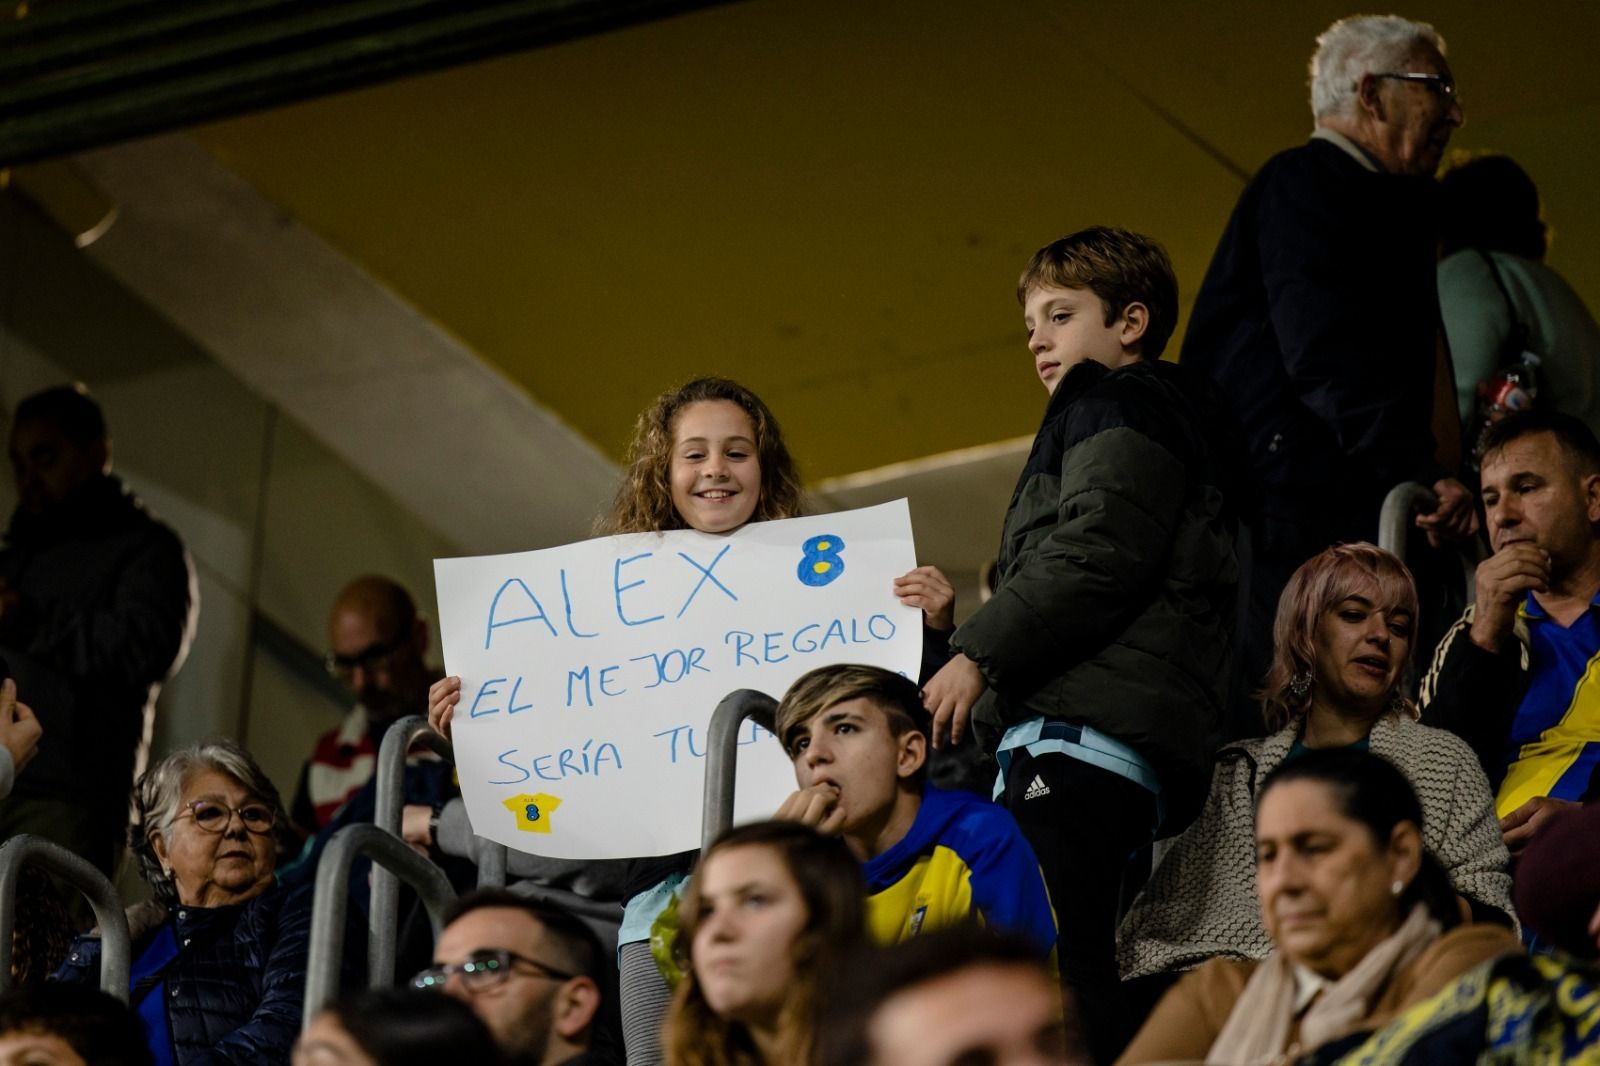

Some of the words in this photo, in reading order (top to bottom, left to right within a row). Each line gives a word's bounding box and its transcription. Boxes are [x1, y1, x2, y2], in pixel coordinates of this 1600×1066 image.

[485, 544, 738, 650] ALEX
[796, 533, 846, 588] 8
[469, 676, 533, 719] EL
[565, 647, 711, 708] MEJOR
[724, 614, 897, 666] REGALO
[487, 738, 623, 786] SERÍA
[653, 724, 708, 764] TU
[525, 803, 540, 822] 8
[1024, 786, 1050, 800] adidas
